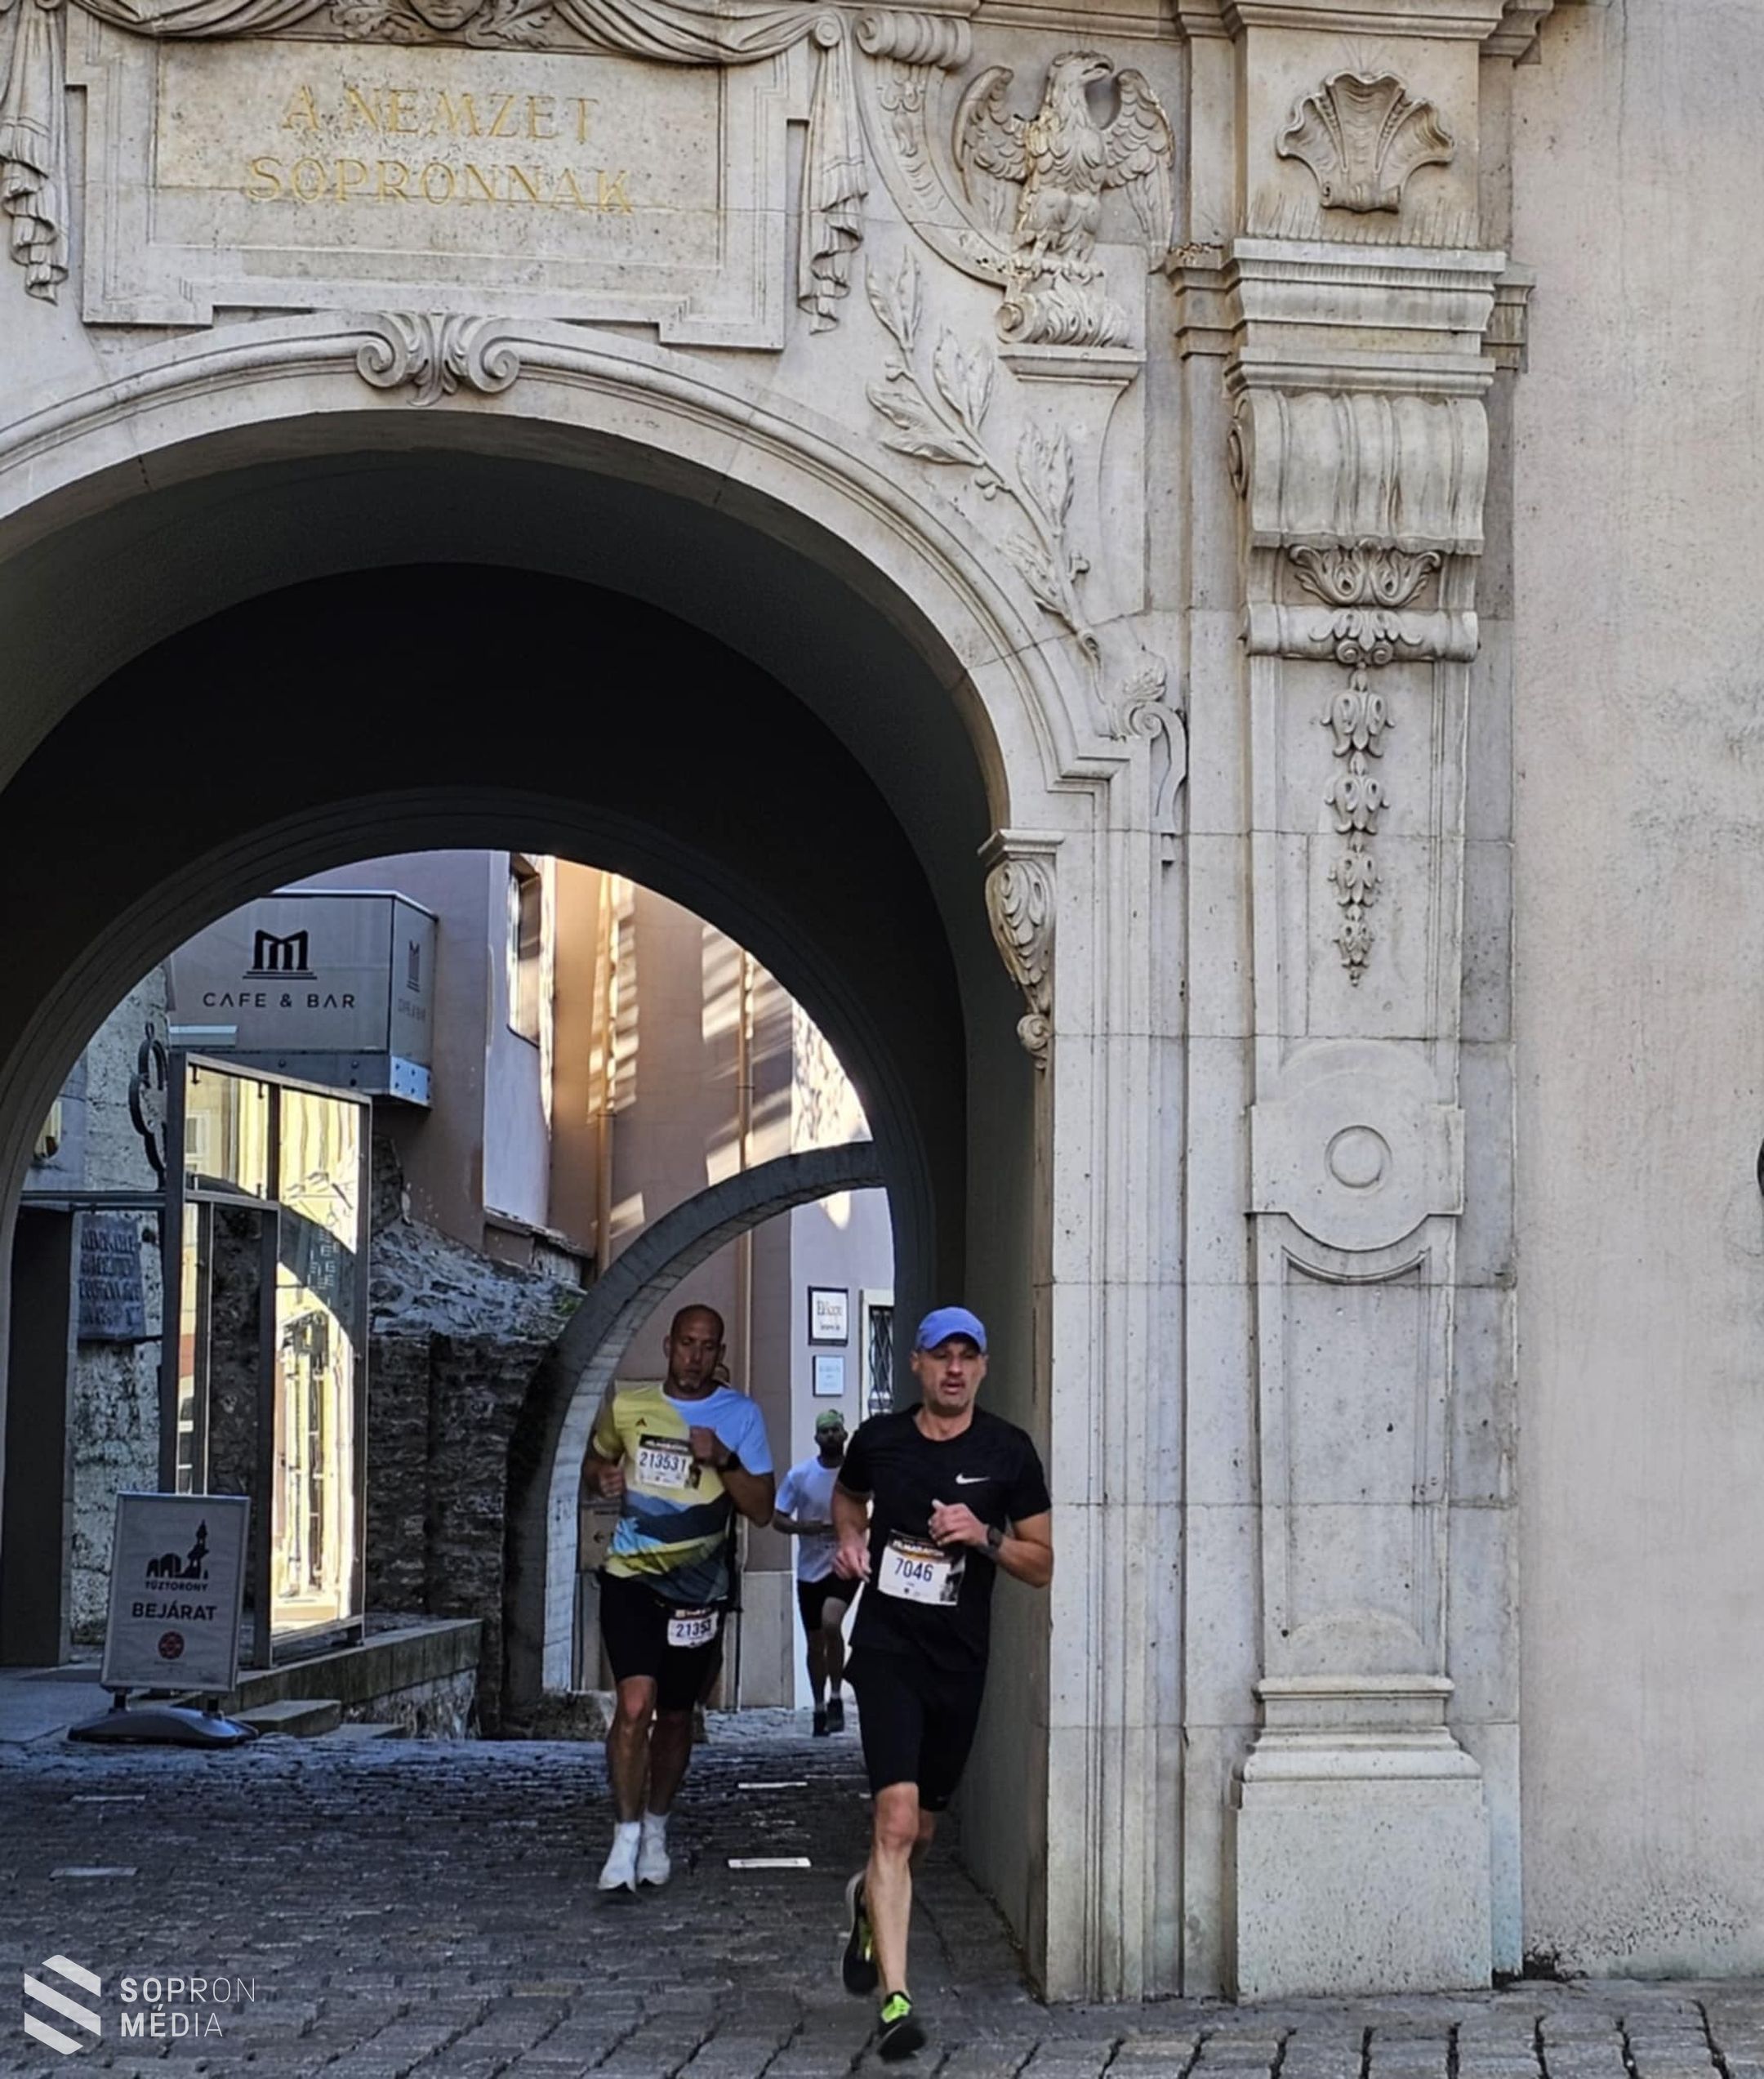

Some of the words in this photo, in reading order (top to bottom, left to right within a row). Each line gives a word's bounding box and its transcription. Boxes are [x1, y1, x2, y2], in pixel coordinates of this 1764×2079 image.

[282, 84, 320, 131] A
[343, 86, 599, 145] NEMZET
[247, 155, 634, 215] SOPRONNAK
[203, 993, 266, 1007] CAFE
[280, 993, 292, 1007] &
[307, 993, 355, 1008] BAR
[639, 1452, 687, 1473] 213531
[895, 1557, 933, 1582] 7046
[132, 1599, 218, 1621] BEJÁRAT
